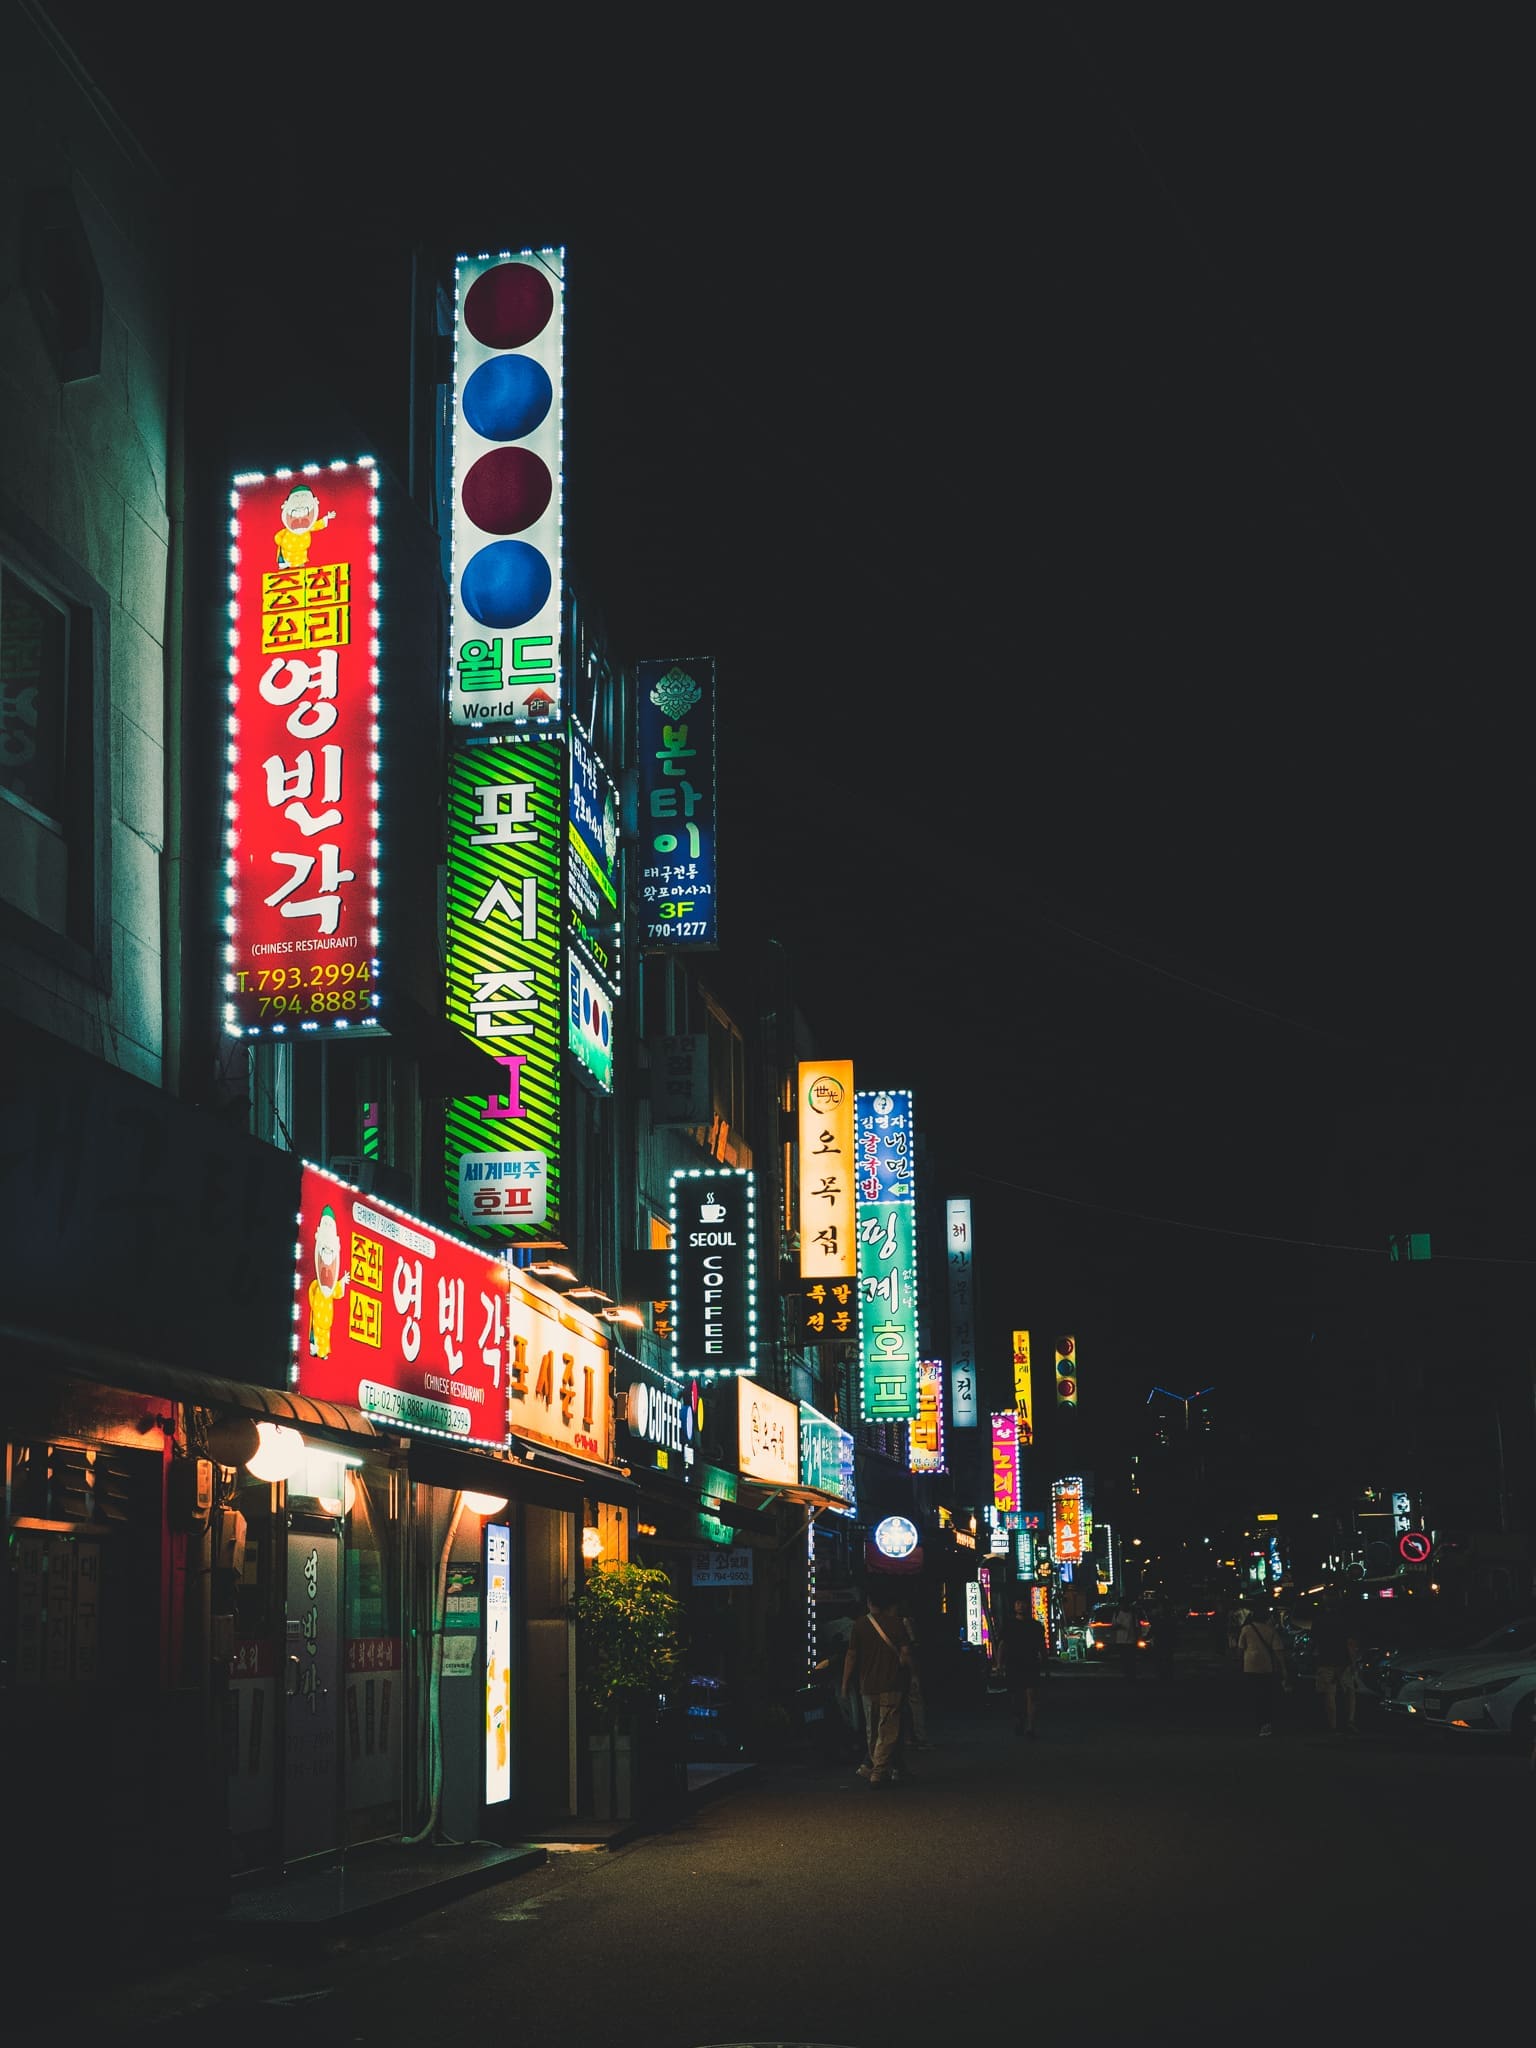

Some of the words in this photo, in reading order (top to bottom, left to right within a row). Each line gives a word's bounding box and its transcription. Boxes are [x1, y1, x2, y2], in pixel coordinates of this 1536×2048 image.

[266, 566, 350, 607] 중화
[265, 607, 350, 651] 요리
[458, 637, 557, 691] 월드
[462, 701, 515, 719] World
[259, 649, 355, 935] 영빈각
[650, 724, 703, 859] 본타이
[643, 885, 712, 902] 왓포마사지
[644, 863, 699, 882] 태국전통
[470, 783, 538, 1037] 포시즌
[648, 921, 708, 938] 790-1277
[659, 901, 696, 919] 3F
[251, 940, 294, 957] (CHINESE
[294, 935, 358, 954] RESTAURANT)
[237, 965, 371, 994] T.793.2994
[258, 990, 371, 1017] 794.8885
[464, 1160, 542, 1181] 세계맥주
[860, 1132, 883, 1199] 굴국밥
[885, 1132, 910, 1179] 냉면
[473, 1187, 534, 1216] 호프
[811, 1129, 842, 1257] 오목집
[689, 1231, 737, 1247] SEOUL
[352, 1236, 383, 1290] 중화
[703, 1255, 724, 1355] COFFEE
[806, 1284, 852, 1305] 족발
[350, 1294, 382, 1346] 요리
[392, 1255, 507, 1389] 영빈각
[806, 1311, 852, 1332] 전문
[870, 1319, 911, 1414] 호프
[648, 1386, 682, 1452] COFFEE
[302, 1549, 320, 1714] 영빈각
